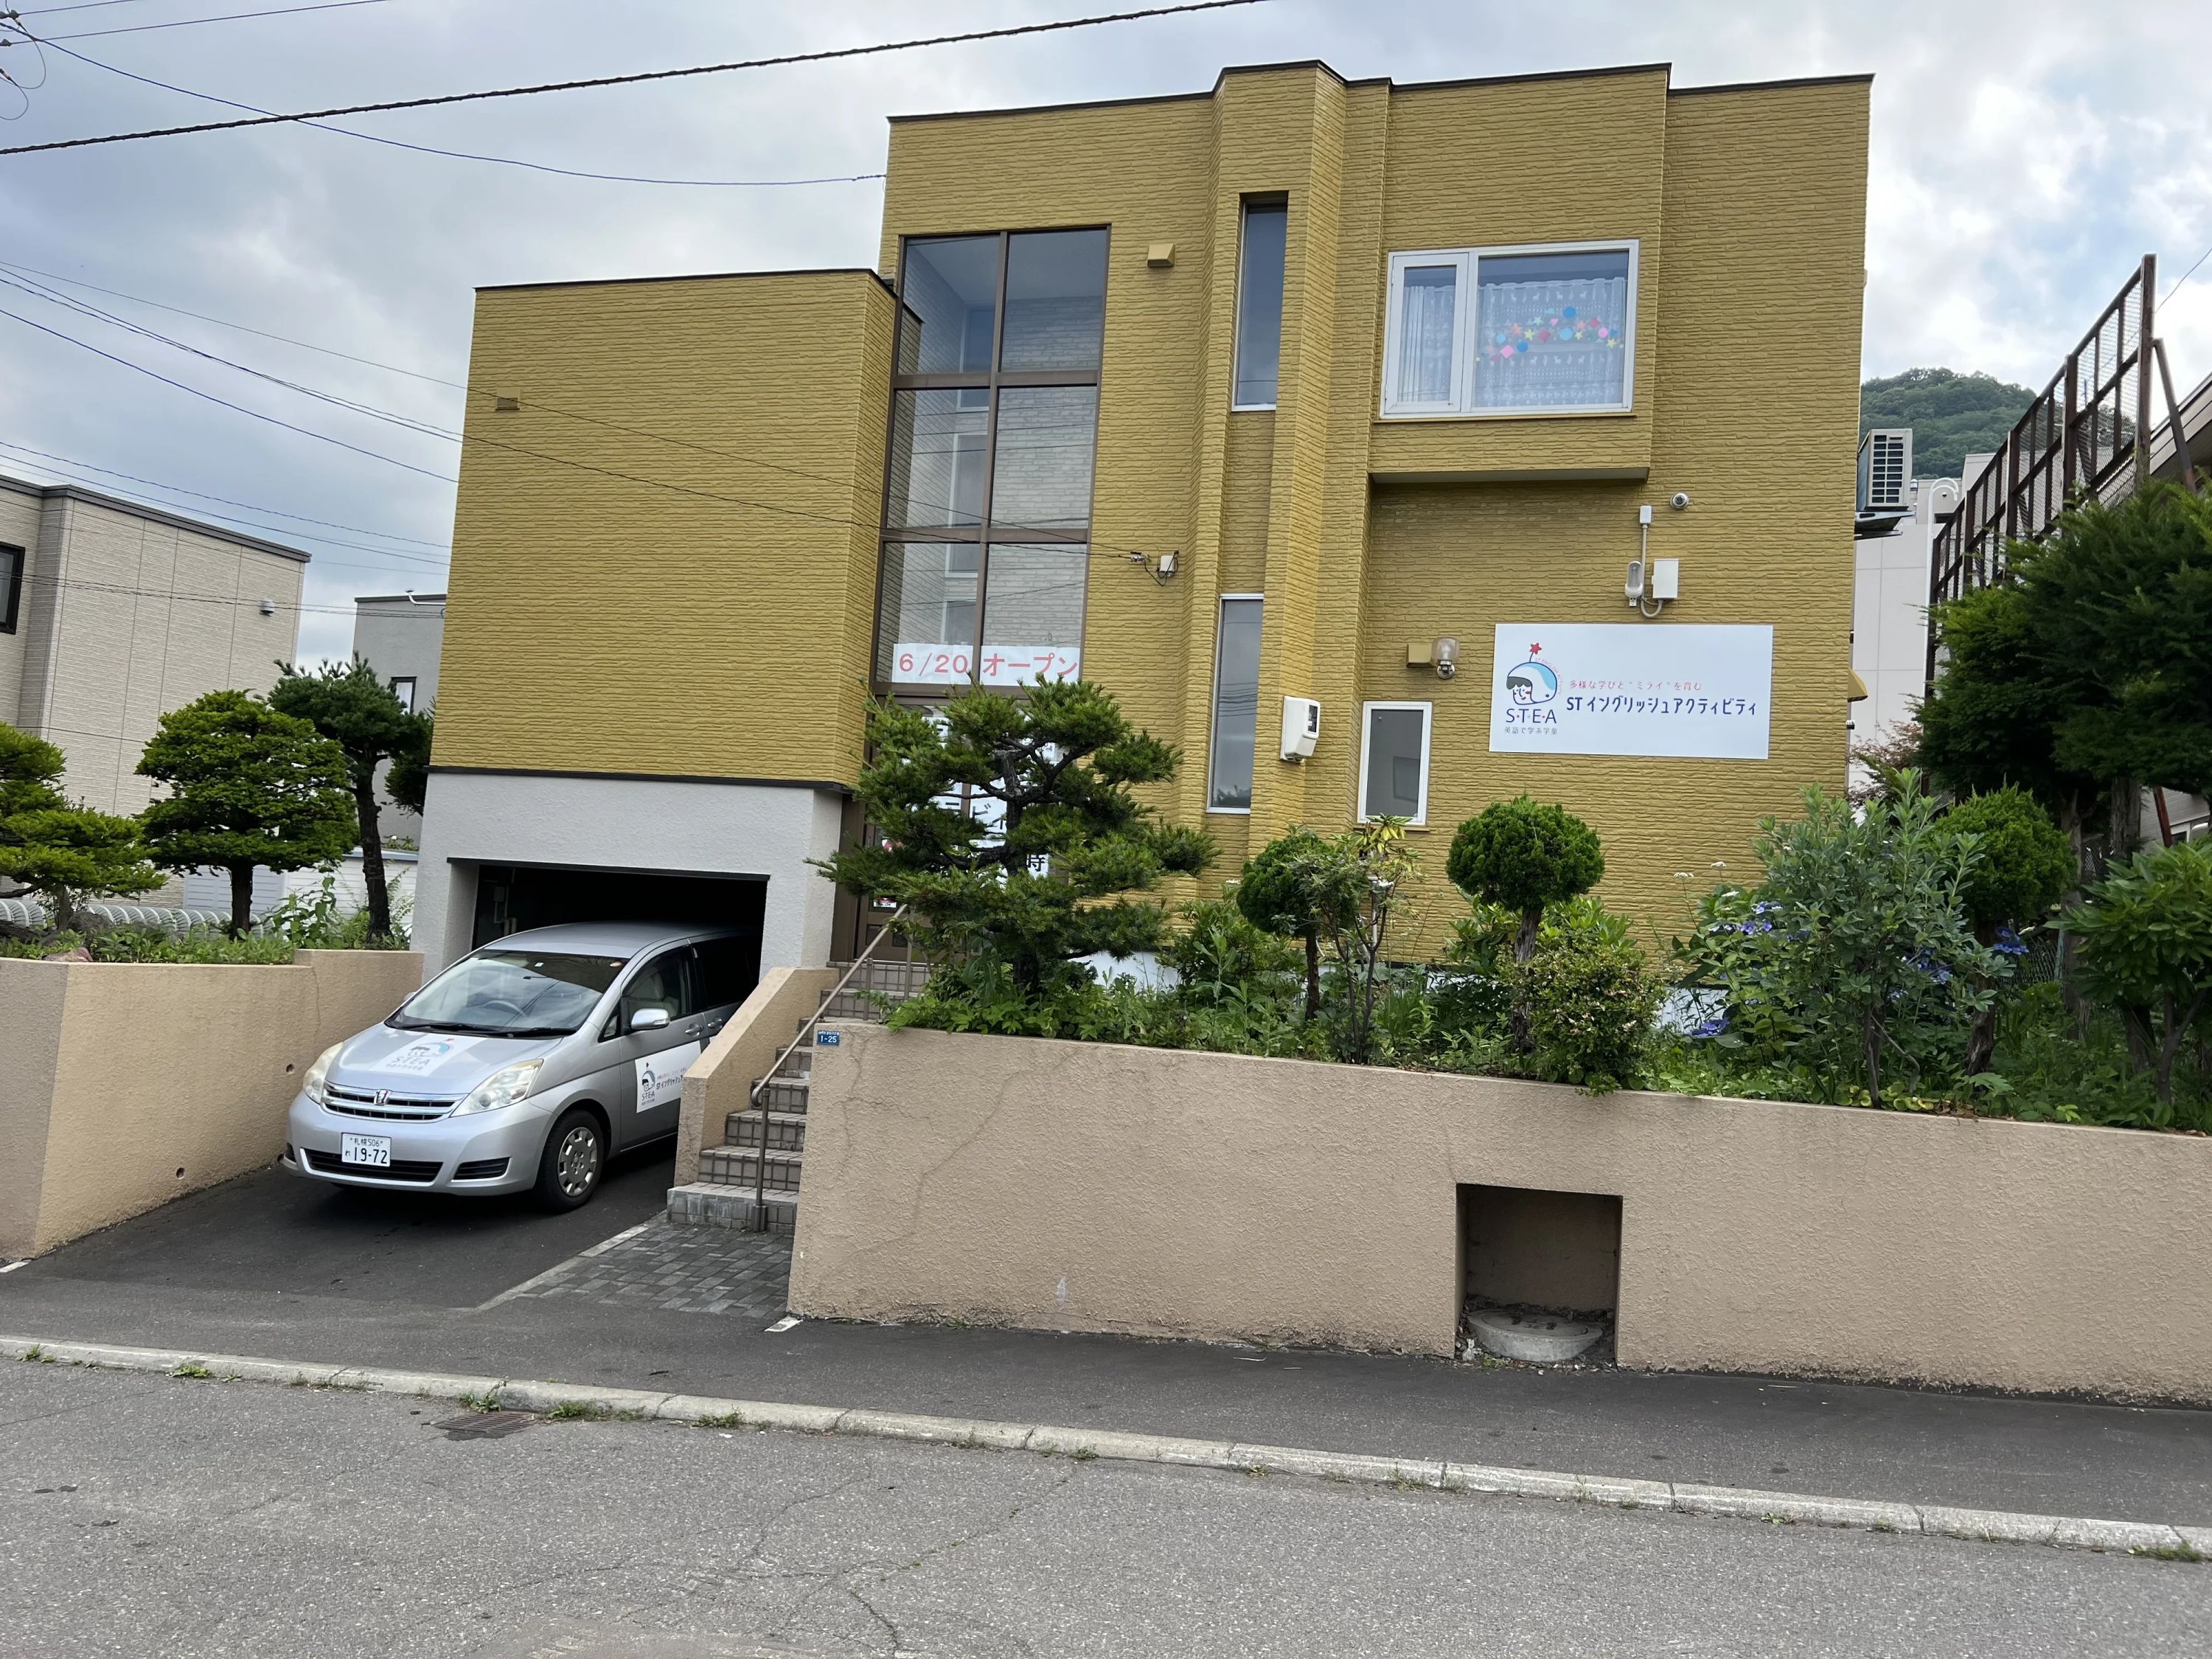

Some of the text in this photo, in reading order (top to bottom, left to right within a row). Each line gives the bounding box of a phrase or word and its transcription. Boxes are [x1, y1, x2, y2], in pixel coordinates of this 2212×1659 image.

[899, 652, 1079, 677] 6/20 オープン
[820, 1035, 837, 1043] 1-25
[354, 1147, 388, 1164] 19-72
